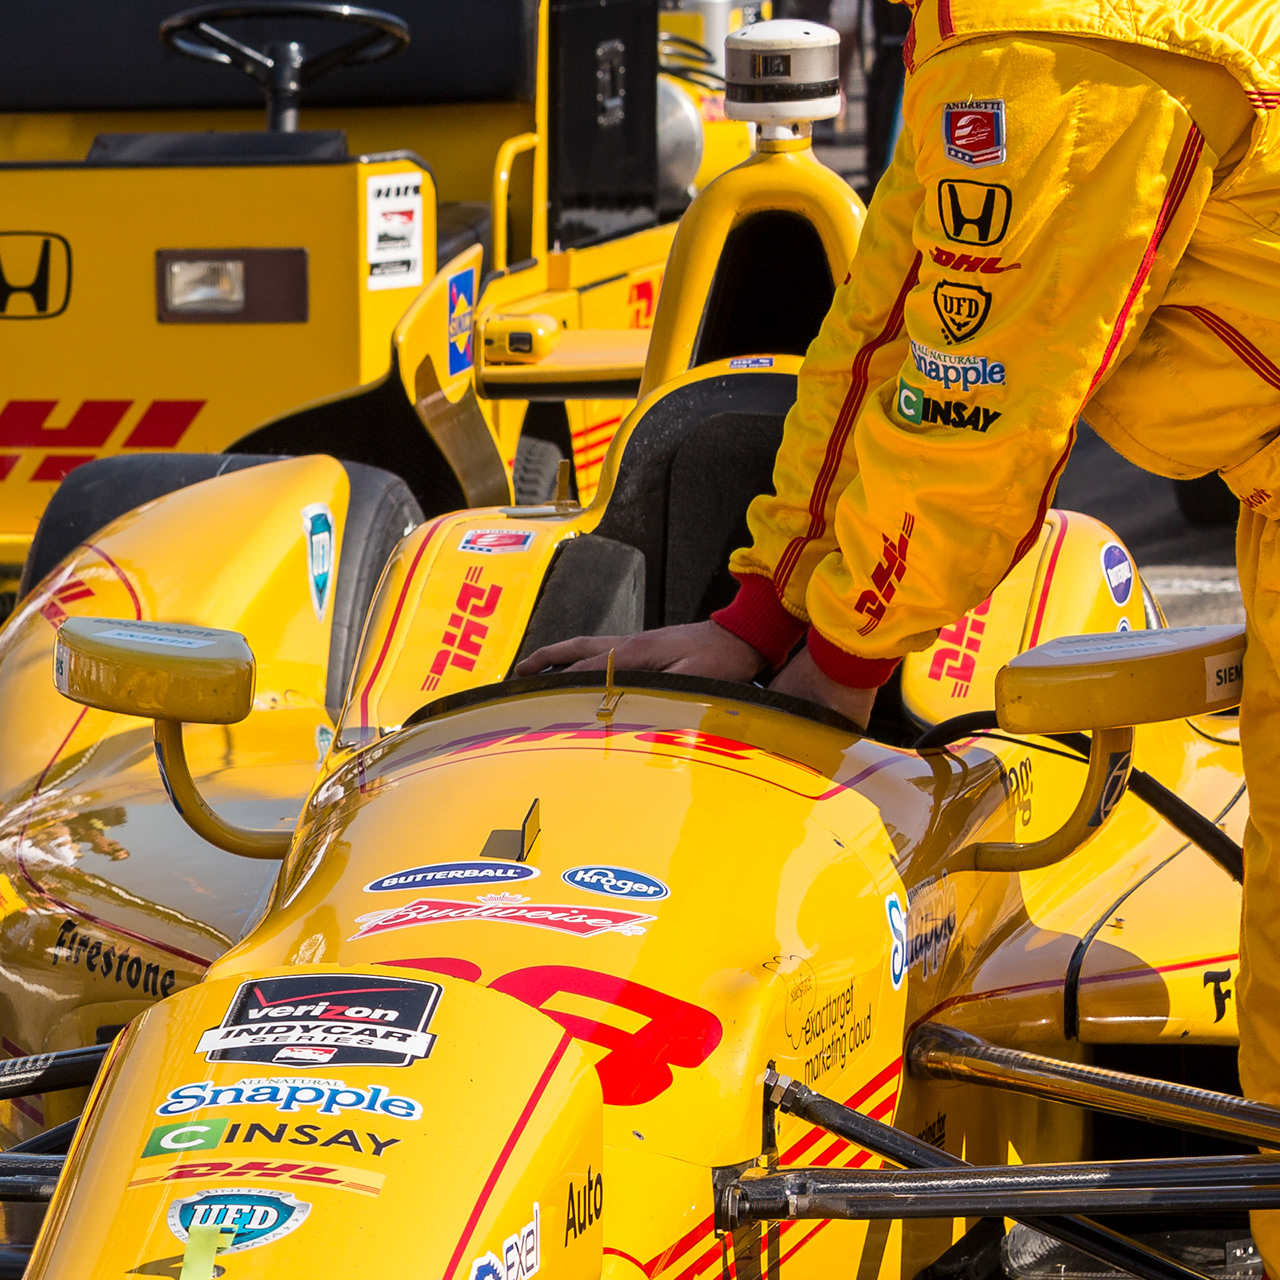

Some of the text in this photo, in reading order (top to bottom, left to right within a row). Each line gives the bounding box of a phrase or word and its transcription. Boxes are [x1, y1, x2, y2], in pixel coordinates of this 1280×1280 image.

[945, 101, 1002, 111] ANDRETTI
[933, 246, 1006, 274] DHL
[941, 294, 980, 319] UFD
[930, 347, 979, 365] NATURAL
[900, 388, 1002, 433] CINSAY
[854, 532, 910, 622] DHL
[429, 582, 504, 677] DHL
[381, 868, 519, 888] BUTTERBALL
[573, 867, 661, 896] Kroger
[888, 871, 957, 985] Snapple
[52, 917, 176, 999] Firestone
[248, 1001, 400, 1022] verizon
[804, 980, 855, 1046] exacttarget
[219, 1024, 416, 1043] INDYCAR
[249, 1034, 375, 1046] SERIES
[804, 1002, 873, 1086] marketing cloud
[236, 1078, 342, 1087] ALL NATURAL
[156, 1083, 417, 1118] Snapple
[159, 1123, 402, 1157] CINSAY
[160, 1161, 344, 1186] DHL
[190, 1204, 280, 1230] UFD
[565, 1164, 604, 1249] Auto
